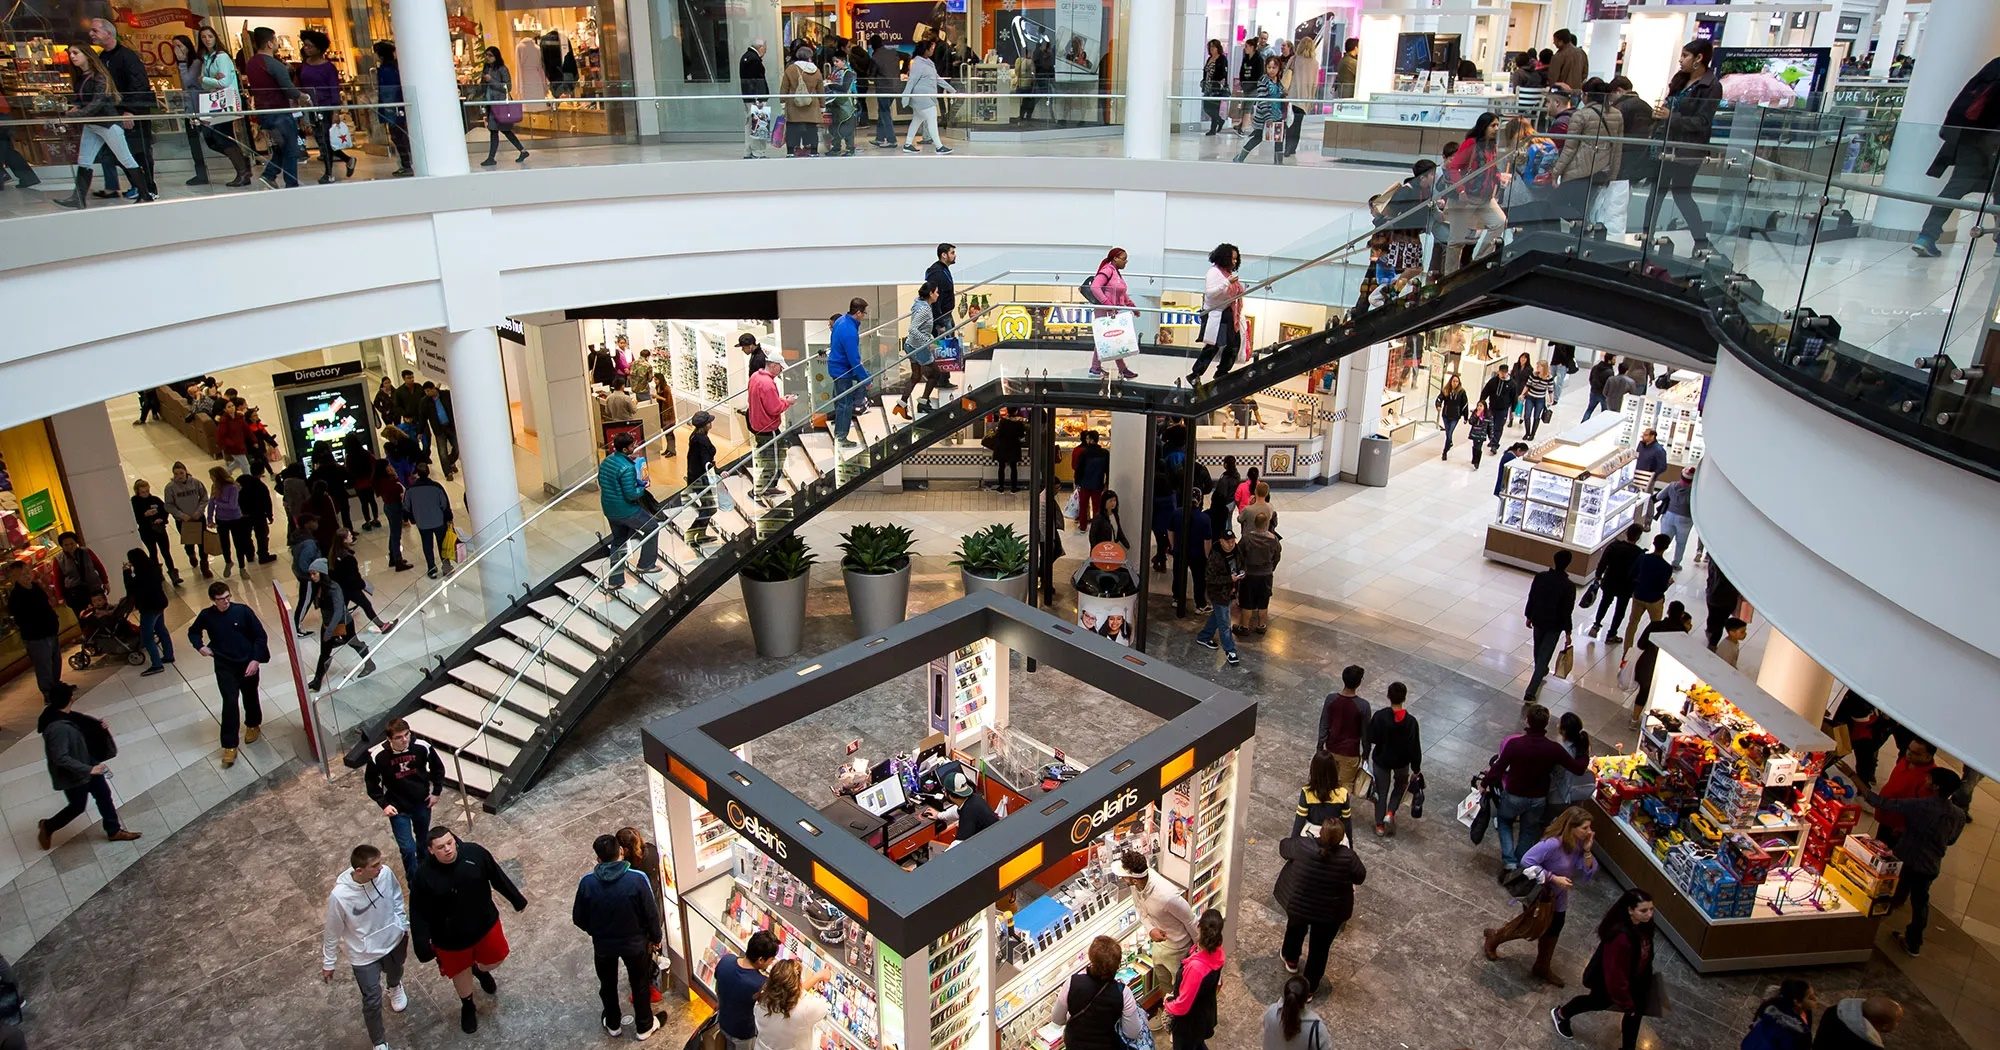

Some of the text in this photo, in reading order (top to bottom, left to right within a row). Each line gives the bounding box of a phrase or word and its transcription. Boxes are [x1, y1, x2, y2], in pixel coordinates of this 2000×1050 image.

[865, 21, 879, 30] your
[295, 366, 341, 381] Directory
[27, 504, 44, 518] FREE!
[399, 760, 411, 772] K
[883, 955, 897, 1005] DEVICE
